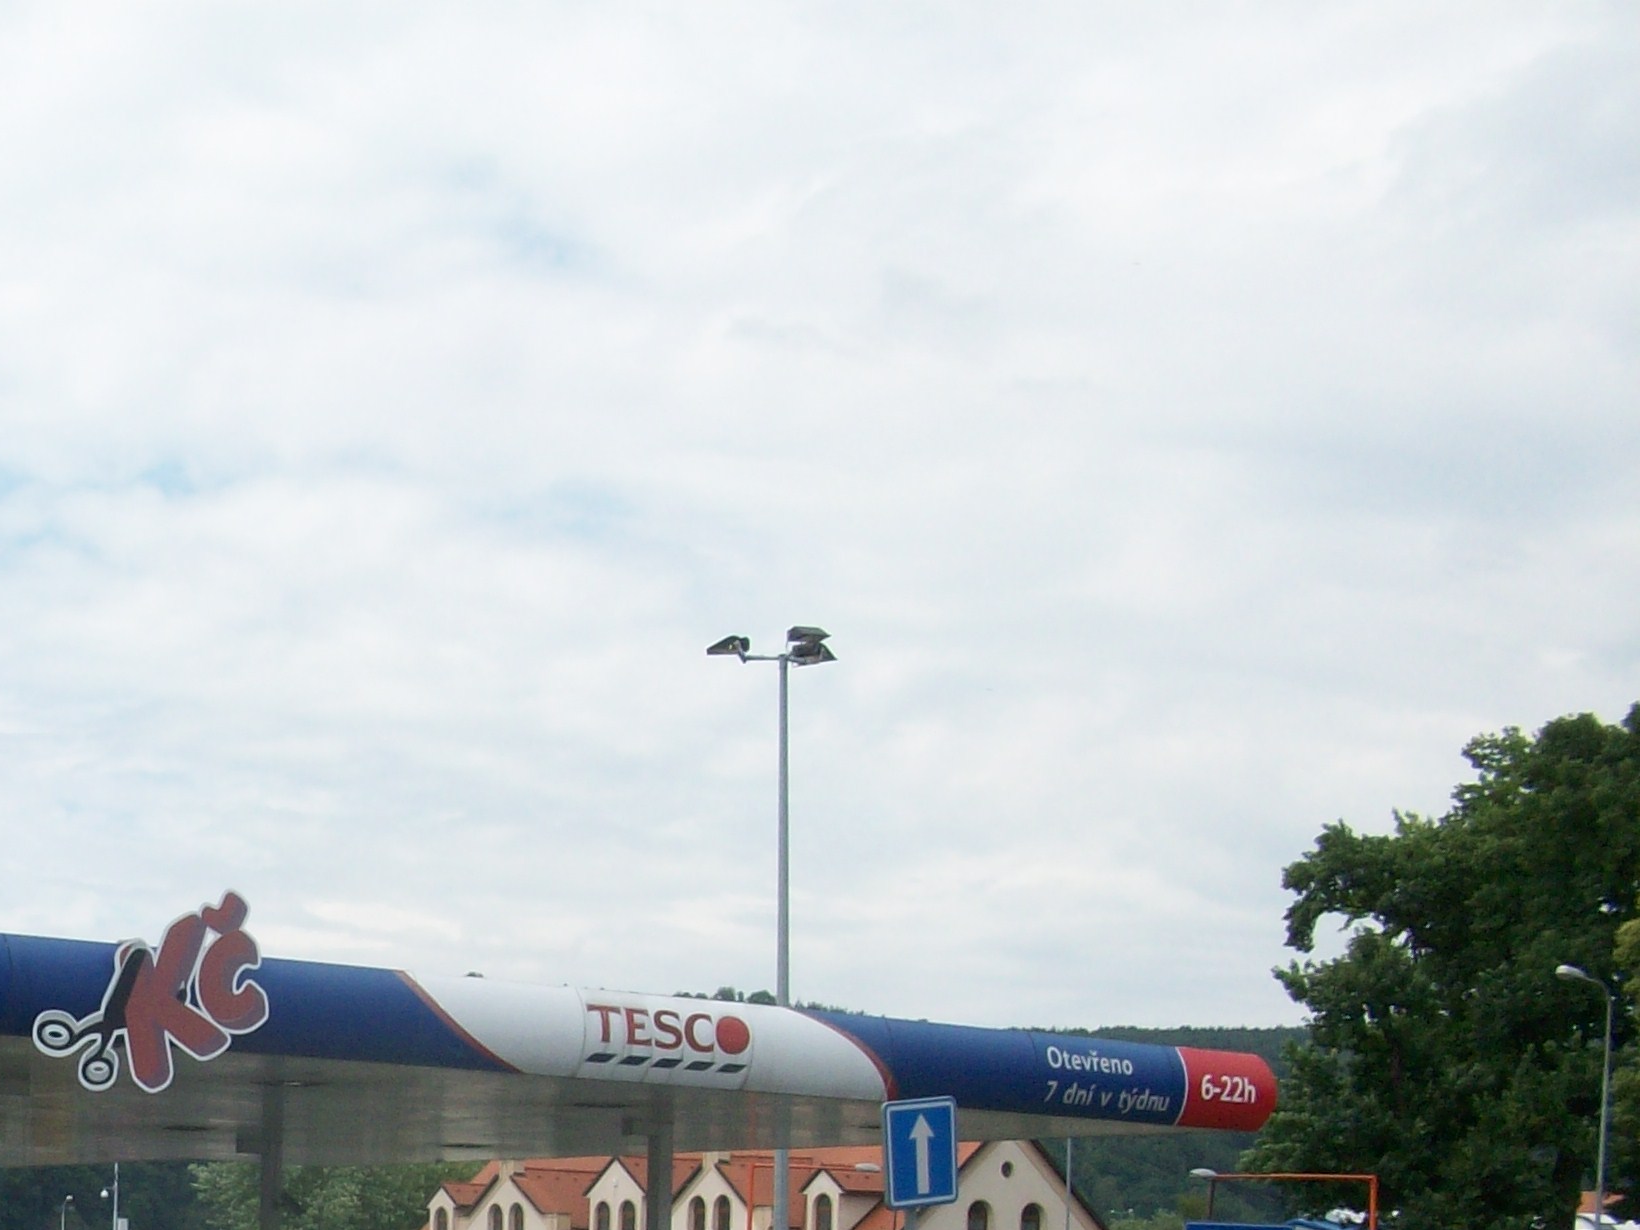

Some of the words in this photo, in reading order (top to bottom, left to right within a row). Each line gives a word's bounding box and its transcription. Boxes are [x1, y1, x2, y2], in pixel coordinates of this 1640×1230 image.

[586, 1003, 751, 1056] TESCO
[1047, 1044, 1134, 1076] Otevřeno
[1043, 1079, 1059, 1103] 7
[1063, 1079, 1096, 1106] dní
[1101, 1091, 1113, 1107] v
[1117, 1085, 1171, 1115] týdnu
[1200, 1074, 1257, 1104] 6-22h
